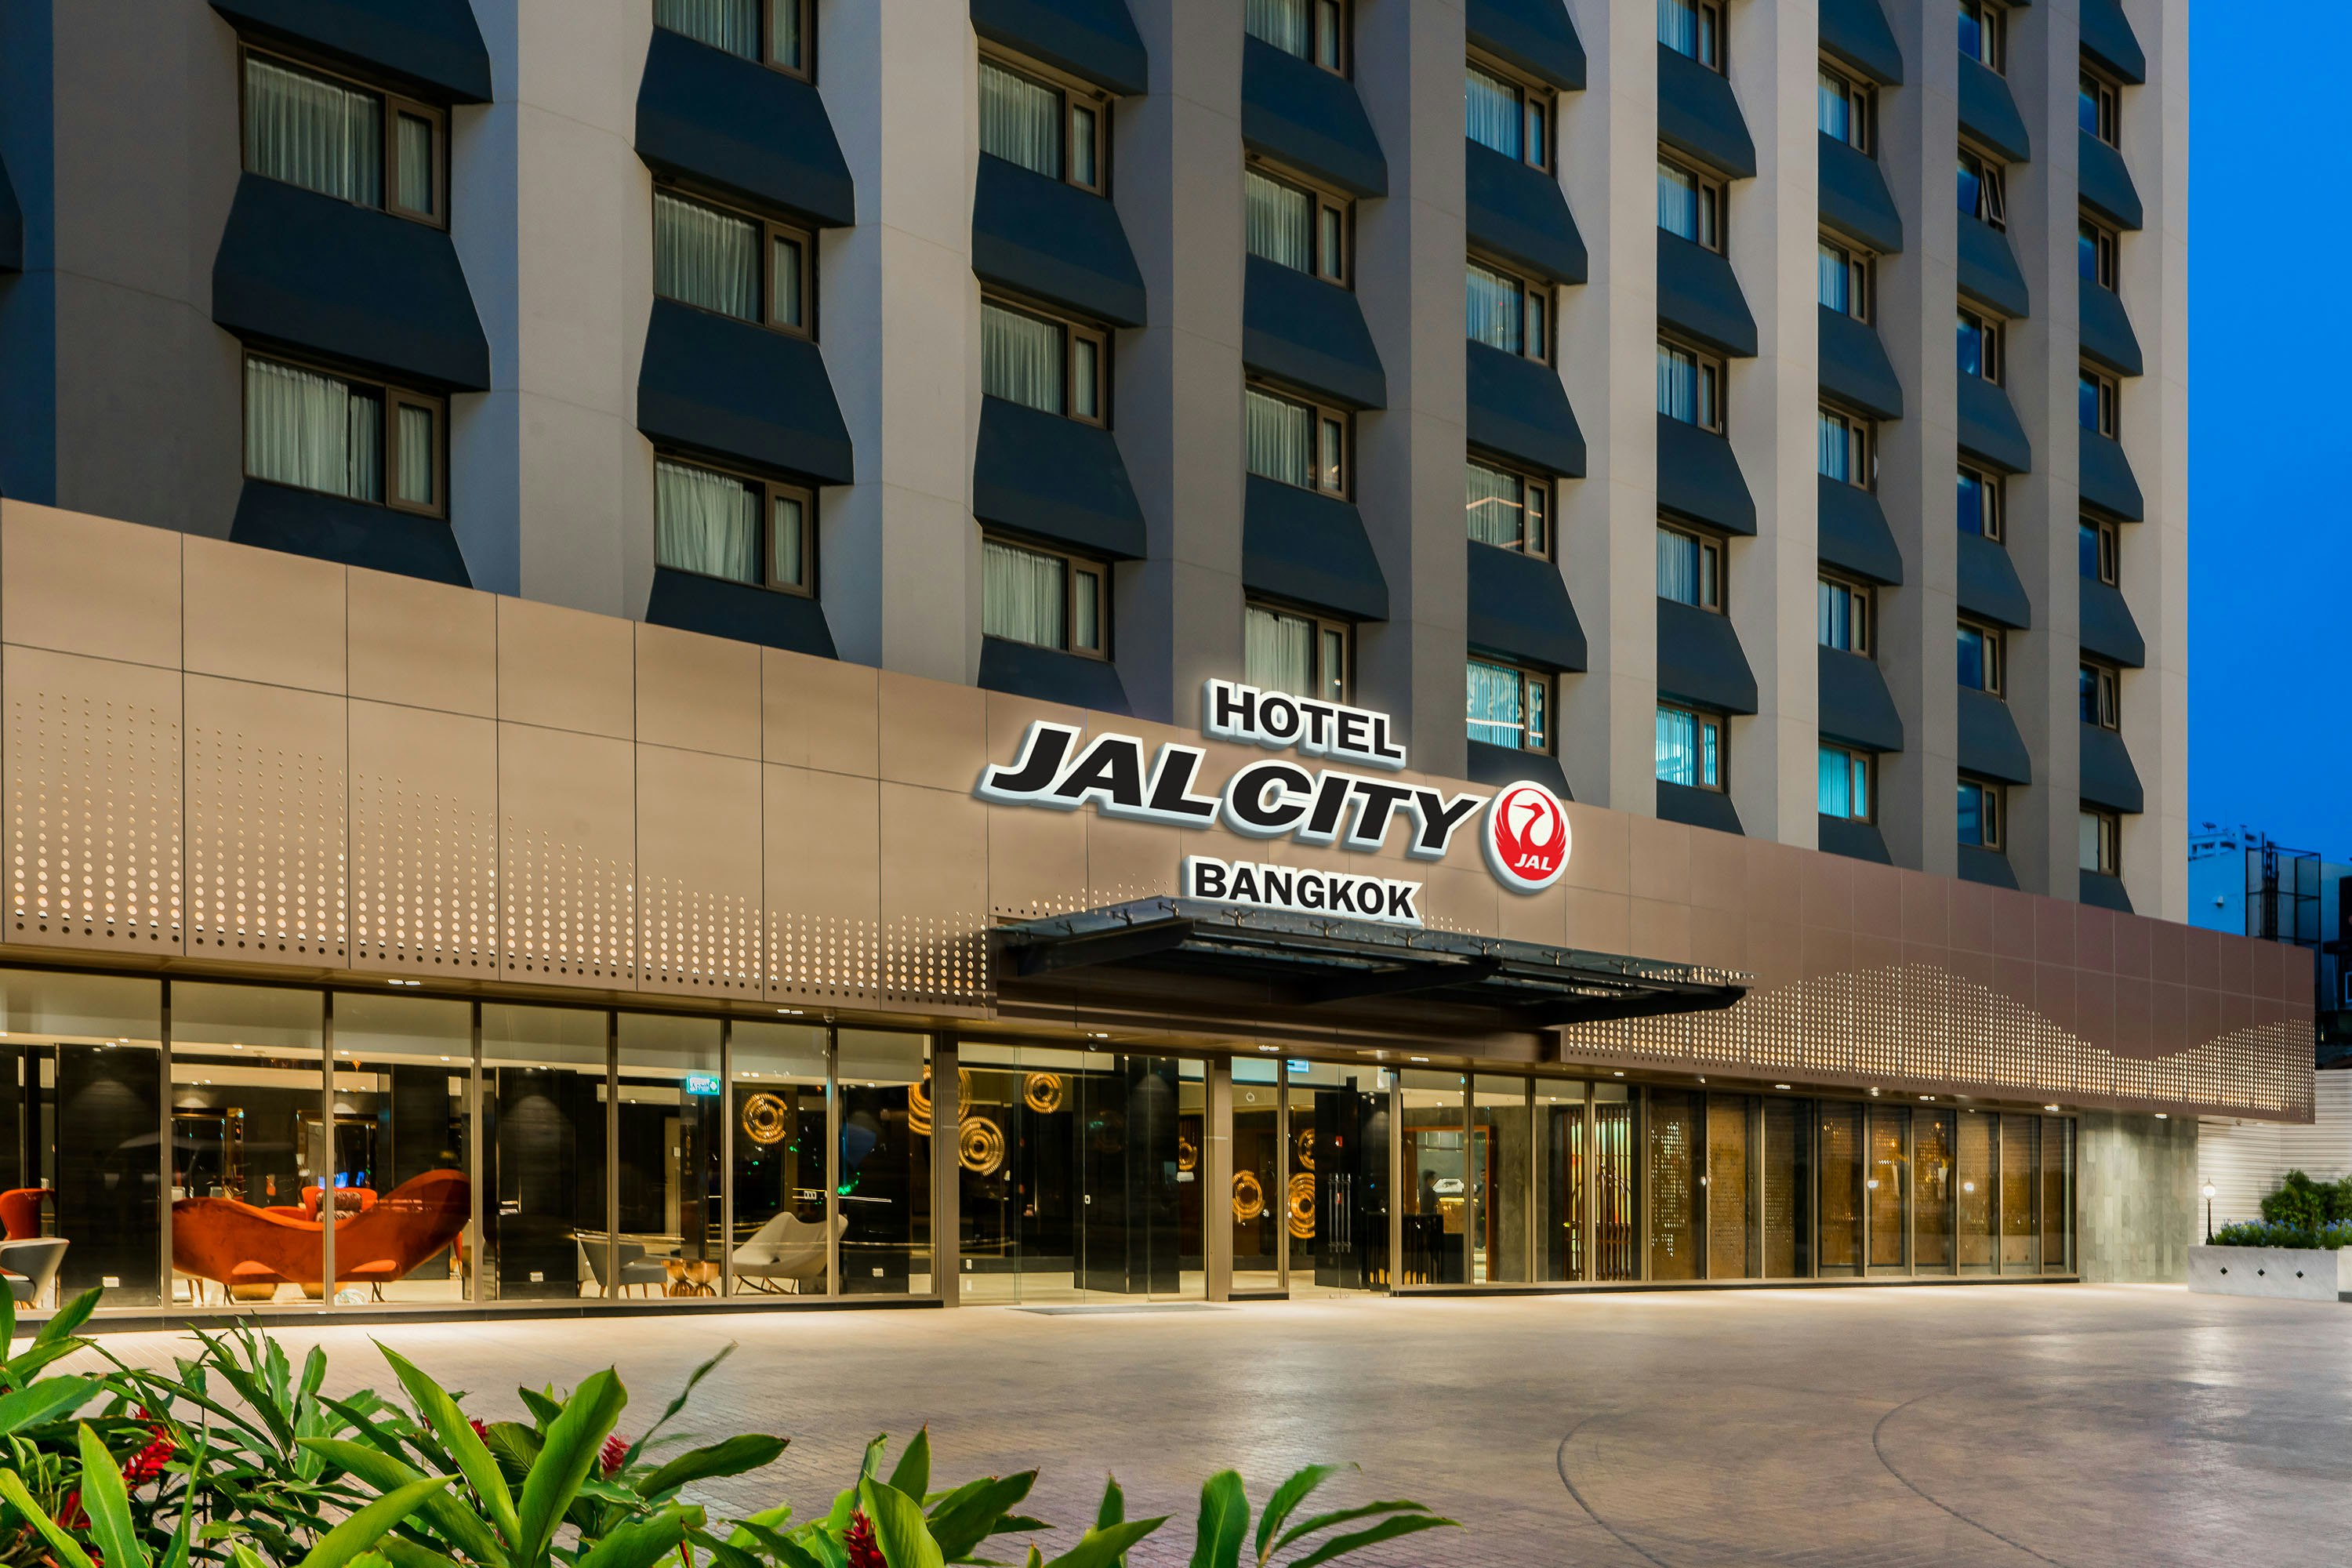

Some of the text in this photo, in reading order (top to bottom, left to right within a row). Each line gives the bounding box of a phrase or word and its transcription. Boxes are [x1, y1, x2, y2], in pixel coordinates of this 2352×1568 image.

[1217, 687, 1402, 759] HOTEL
[991, 728, 1479, 849] JAL CITY
[1196, 862, 1414, 918] BANGKOK
[1514, 853, 1552, 871] JAL
